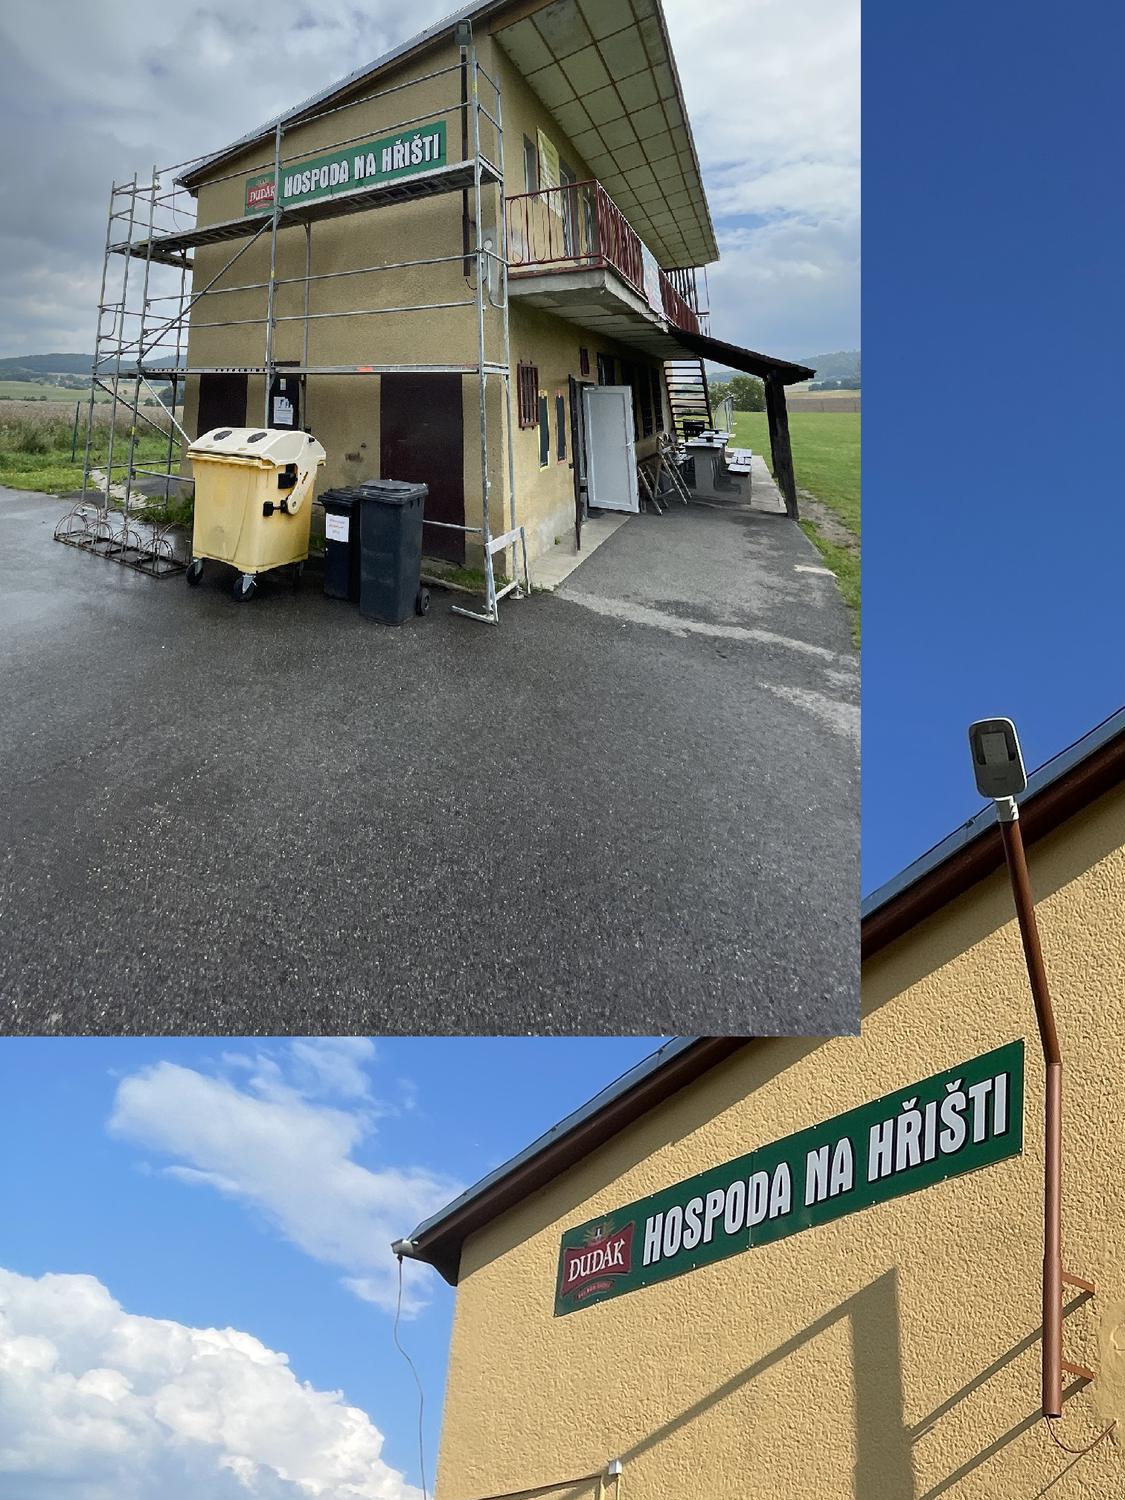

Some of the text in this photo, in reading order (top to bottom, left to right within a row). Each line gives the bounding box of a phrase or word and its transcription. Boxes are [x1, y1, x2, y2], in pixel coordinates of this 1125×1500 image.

[284, 133, 441, 197] HOSPODA NA HŘIŠTI
[642, 1073, 1009, 1266] HOSPODA NA HŘIŠTI
[568, 1238, 626, 1282] DUDÁK
